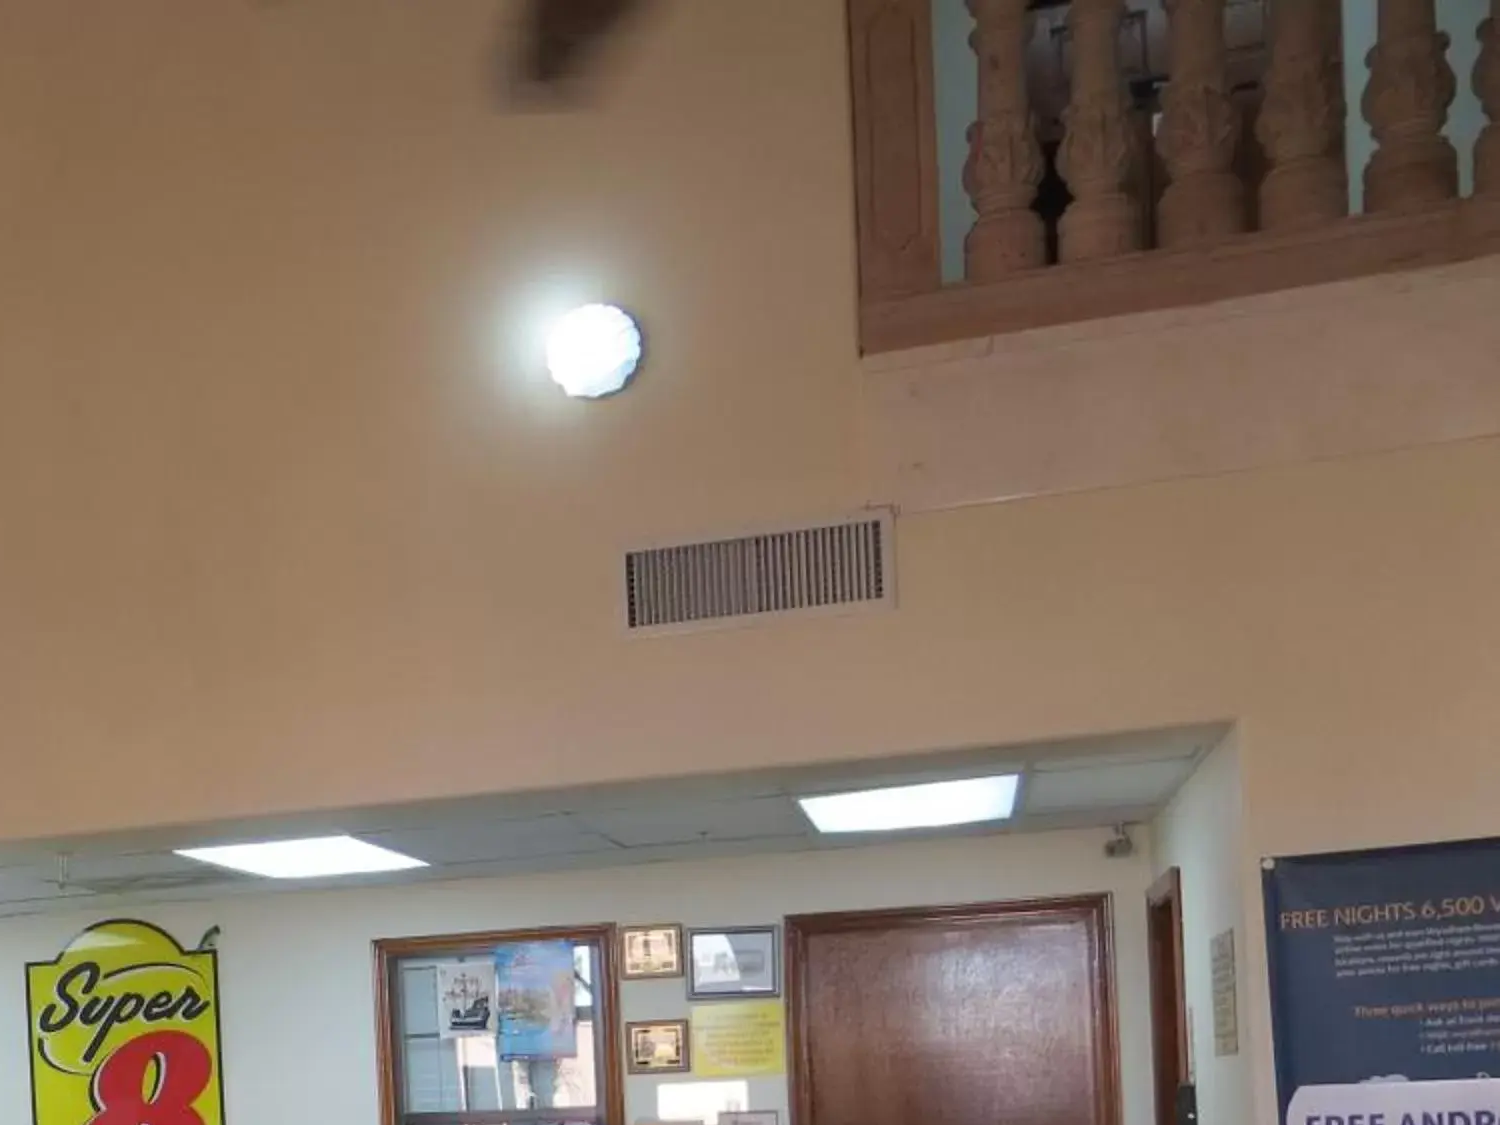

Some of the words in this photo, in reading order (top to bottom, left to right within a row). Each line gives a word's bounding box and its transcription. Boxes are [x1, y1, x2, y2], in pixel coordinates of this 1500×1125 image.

[1279, 908, 1329, 929] FREE
[1333, 902, 1416, 926] NIGHTS
[1421, 895, 1485, 920] 6,500
[39, 962, 211, 1063] Super
